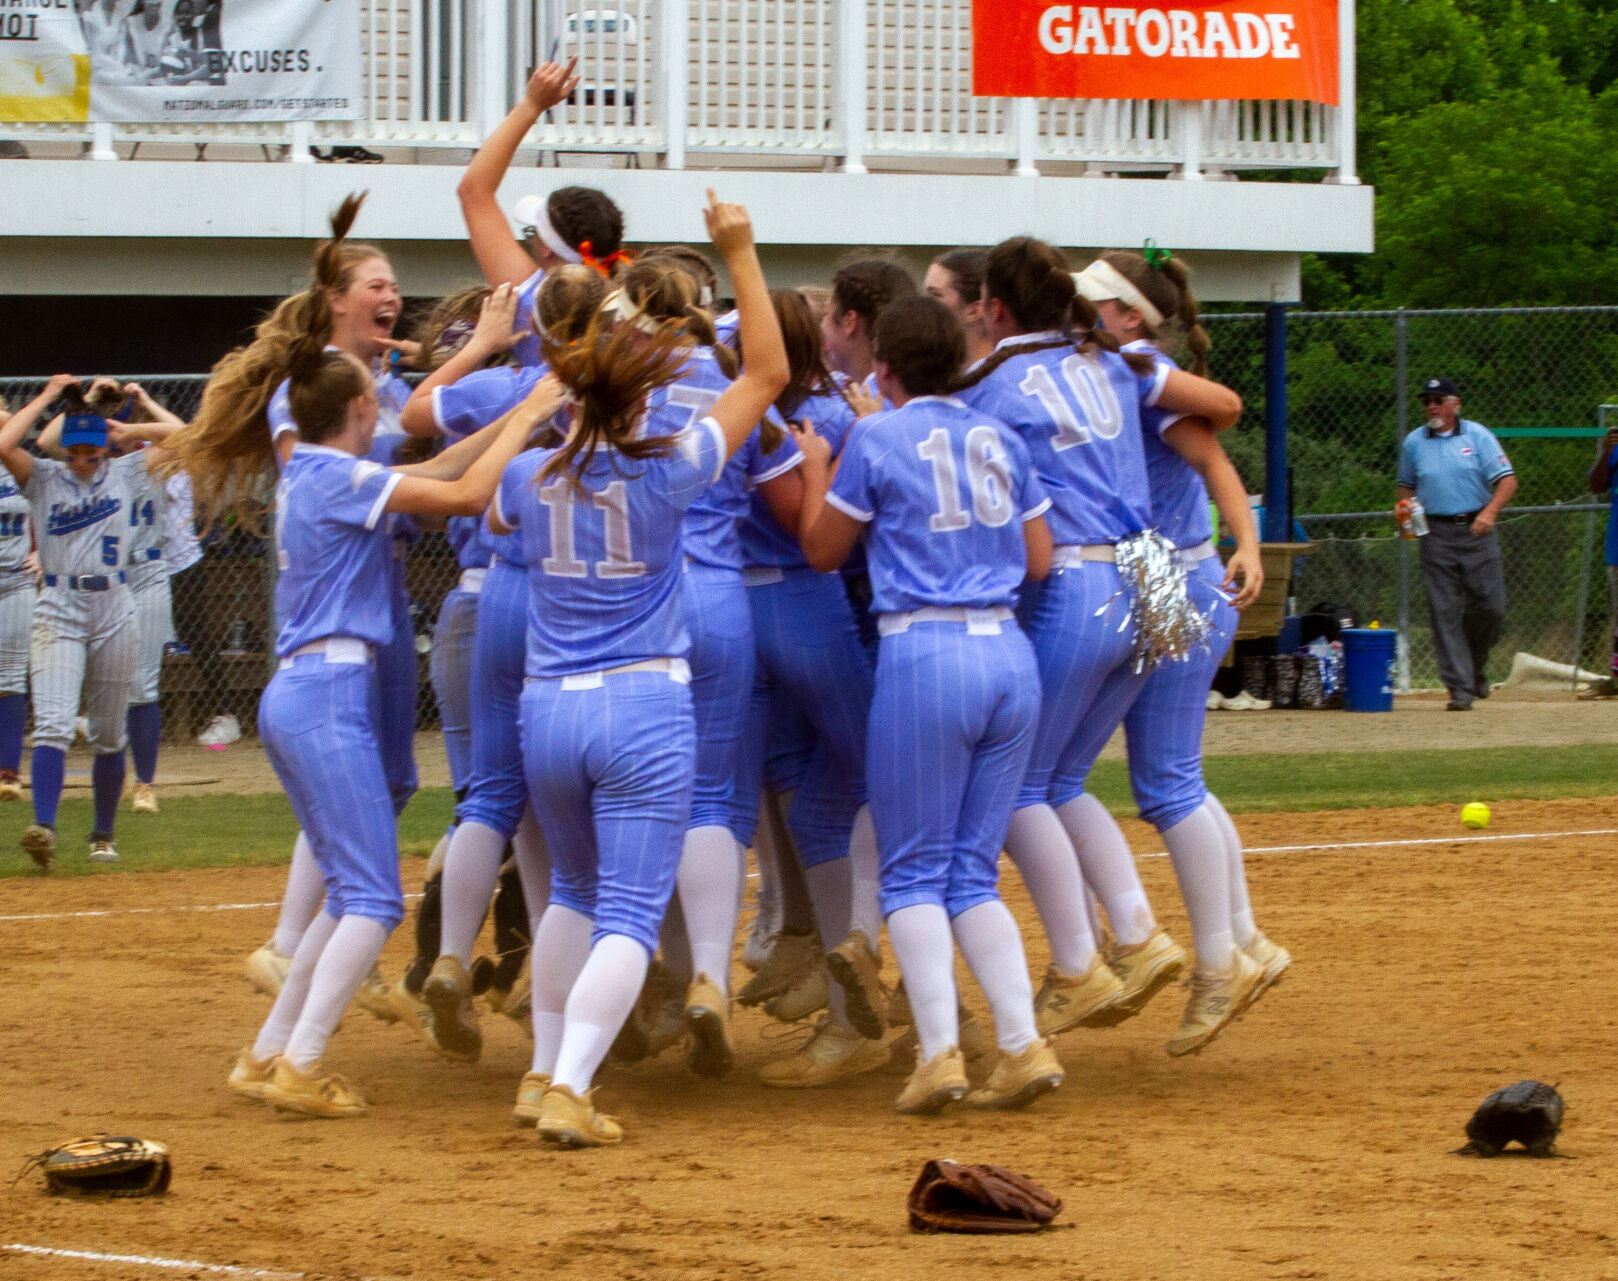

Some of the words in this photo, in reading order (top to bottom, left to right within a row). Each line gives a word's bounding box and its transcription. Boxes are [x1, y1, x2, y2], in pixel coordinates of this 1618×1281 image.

[207, 49, 323, 73] EXCUSES.
[1038, 5, 1300, 59] GATORADE
[1018, 354, 1123, 452] 10
[917, 426, 1014, 533] 16
[102, 536, 120, 567] 5
[540, 477, 646, 579] 11
